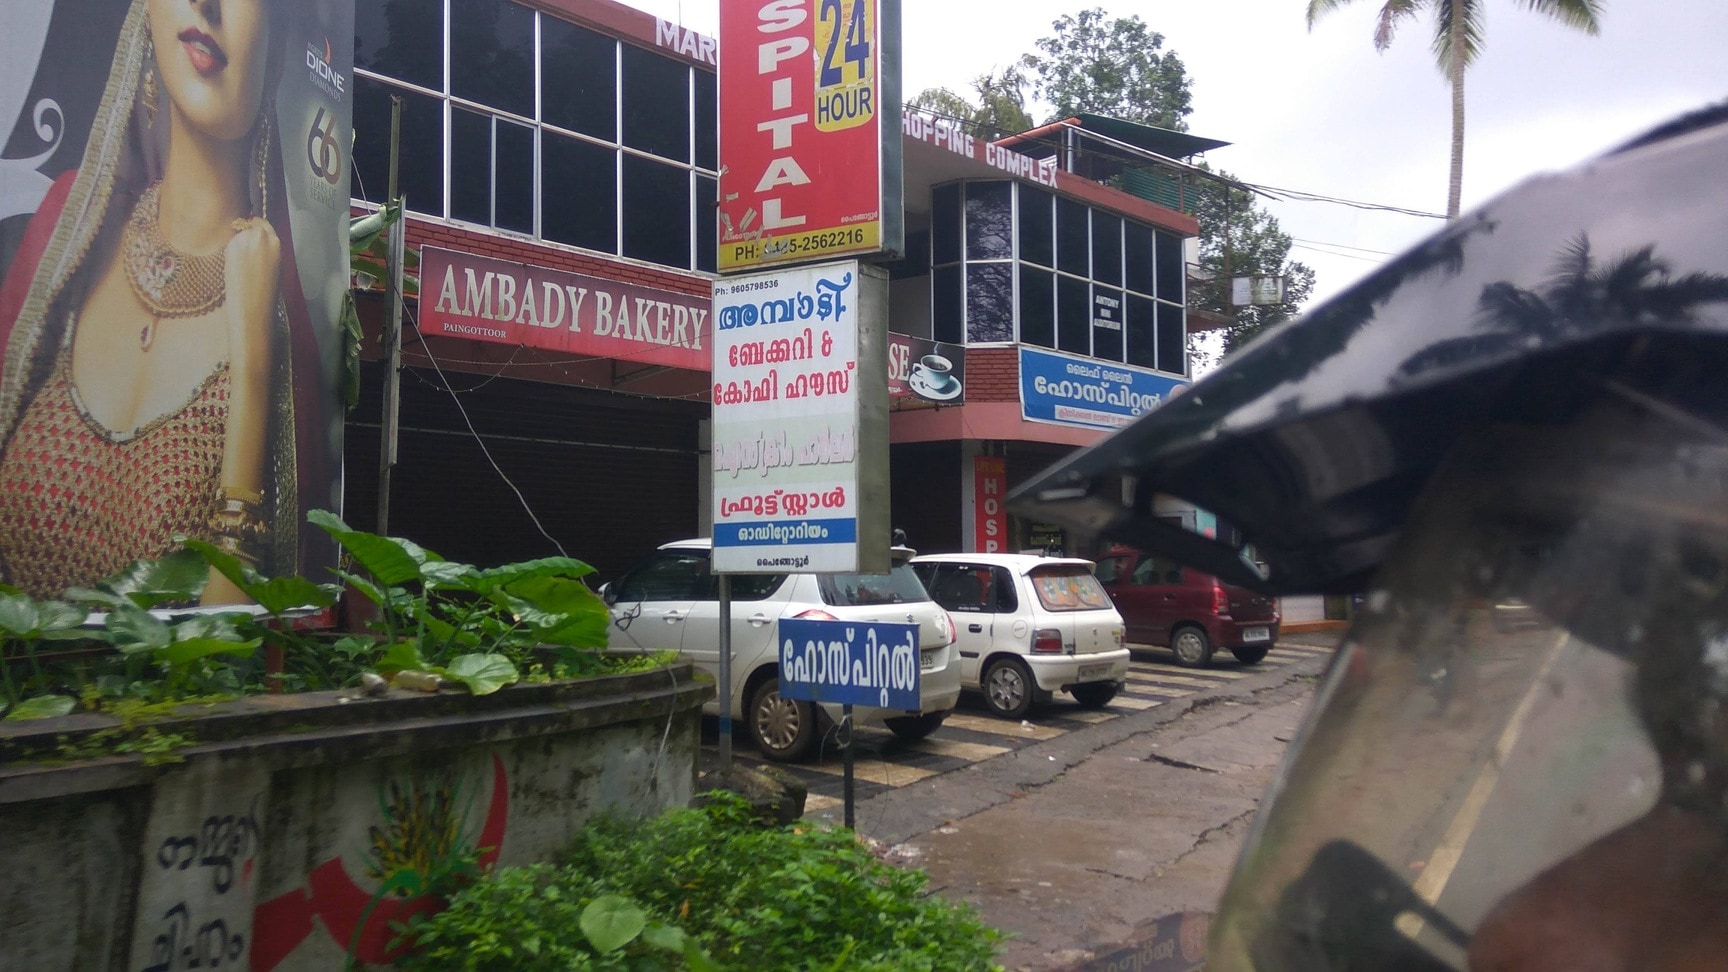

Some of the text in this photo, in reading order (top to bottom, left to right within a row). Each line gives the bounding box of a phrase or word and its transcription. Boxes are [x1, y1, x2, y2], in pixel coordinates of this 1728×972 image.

[820, 0, 870, 88] 24
[306, 50, 345, 93] DIONE
[817, 86, 872, 125] HOUR
[307, 106, 341, 185] 66
[985, 142, 1059, 189] COMPLEX
[735, 244, 760, 261] PH:
[764, 228, 864, 254] 45-2562216
[434, 263, 708, 351] AMBADY BAKERY
[715, 279, 779, 296] Ph: 9605798536
[719, 271, 853, 331] അമ്പാടി
[443, 322, 508, 339] PAINGOTTOOR
[729, 327, 813, 368] ബേക്കറി
[713, 368, 779, 406] കോഫി
[1066, 363, 1102, 379] ലൈഫ്
[1034, 375, 1162, 416] ഹോസ്പിറ്റൽ
[738, 521, 829, 544] ഓഡിറ്റോറിയം
[783, 627, 916, 709] ഹോസ്പിറ്റൽ
